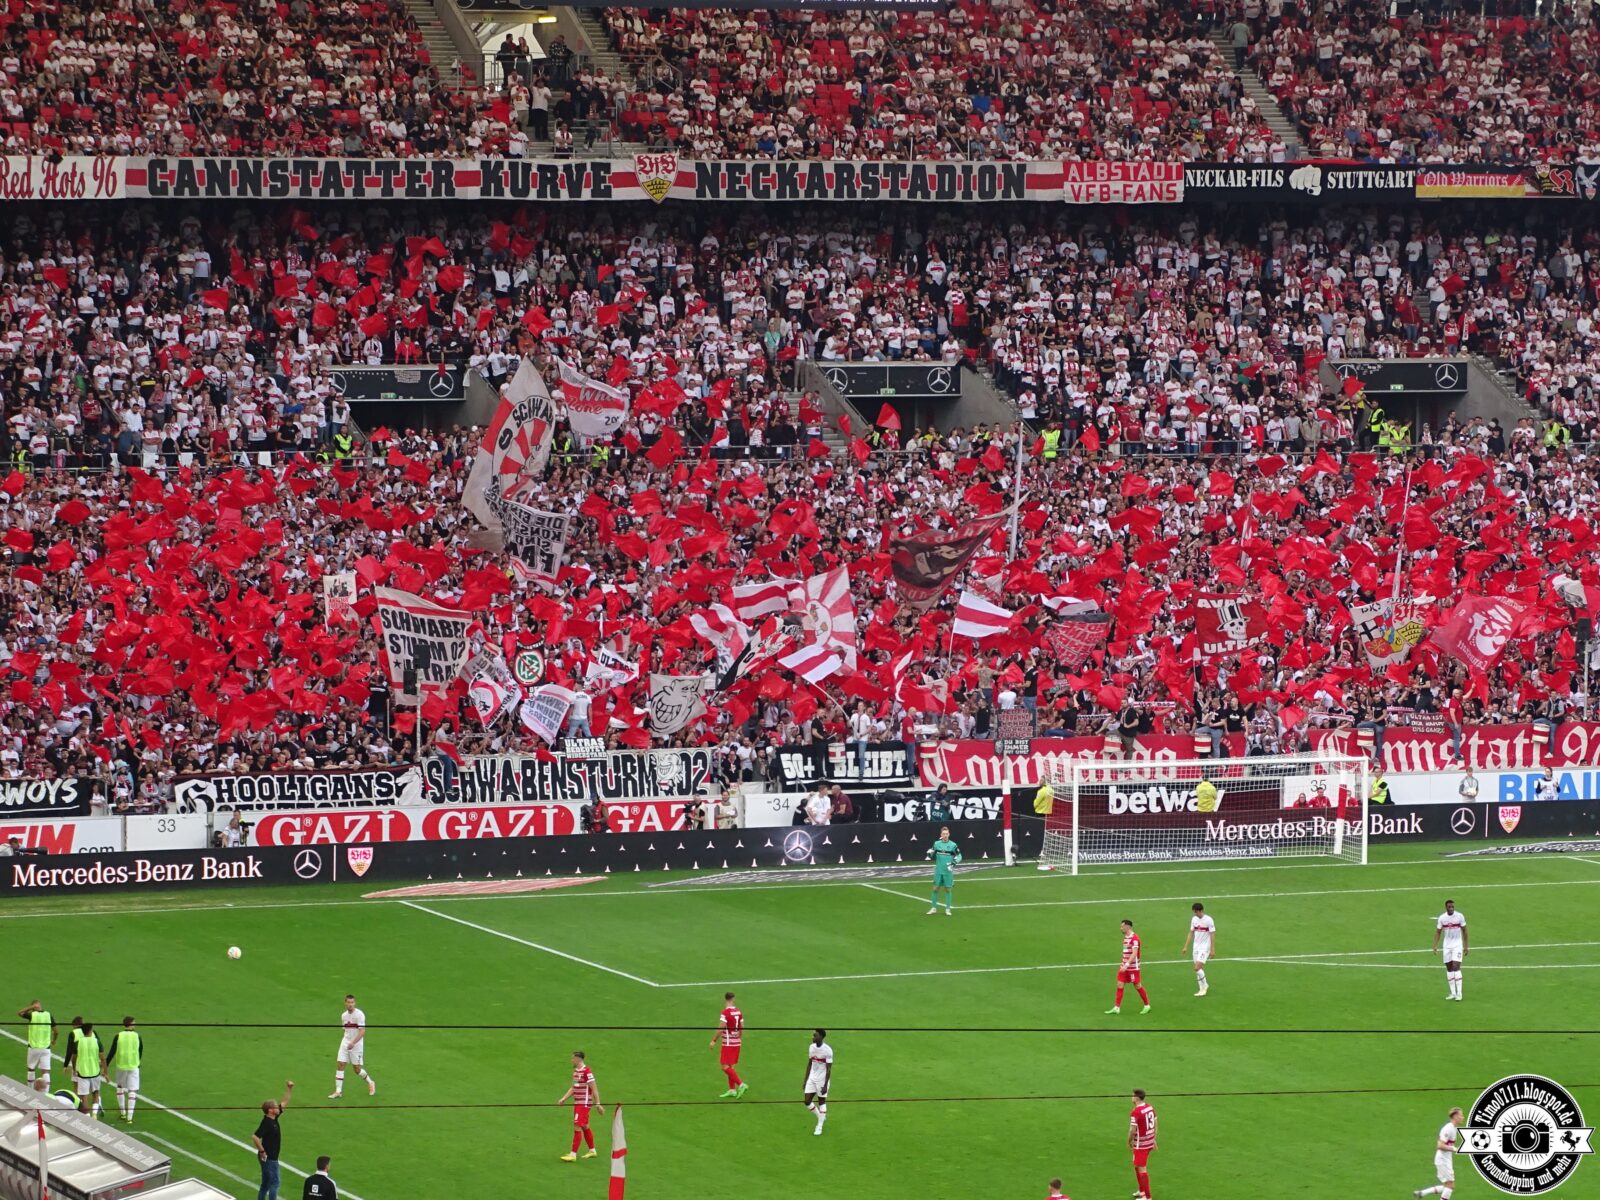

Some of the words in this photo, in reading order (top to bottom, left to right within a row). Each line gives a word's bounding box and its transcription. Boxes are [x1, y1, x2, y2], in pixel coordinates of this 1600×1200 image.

[93, 156, 117, 198] 96
[148, 158, 455, 199] CANNSTATTER
[480, 160, 613, 200] KURVE
[695, 160, 1027, 200] NECKARSTADION
[1068, 162, 1181, 182] ALBSTADT
[1185, 168, 1285, 189] NECKAR-FILS
[1327, 169, 1416, 190] STUTTGART
[1423, 171, 1450, 188] Old
[1452, 171, 1509, 188] Warriors
[1070, 182, 1177, 202] VFB-FANS
[564, 737, 605, 747] ULTRAS
[211, 771, 396, 802] HOOLIGANS
[157, 818, 176, 833] 33
[1369, 812, 1424, 836] Bank
[1079, 850, 1147, 861] Mercedes-Benz
[1148, 849, 1174, 859] Bank
[1179, 847, 1248, 857] Mercedes-Benz
[1249, 845, 1274, 855] Bank
[12, 859, 194, 888] Mercedes-Benz
[201, 855, 263, 880] Bank
[1145, 1112, 1155, 1131] 13
